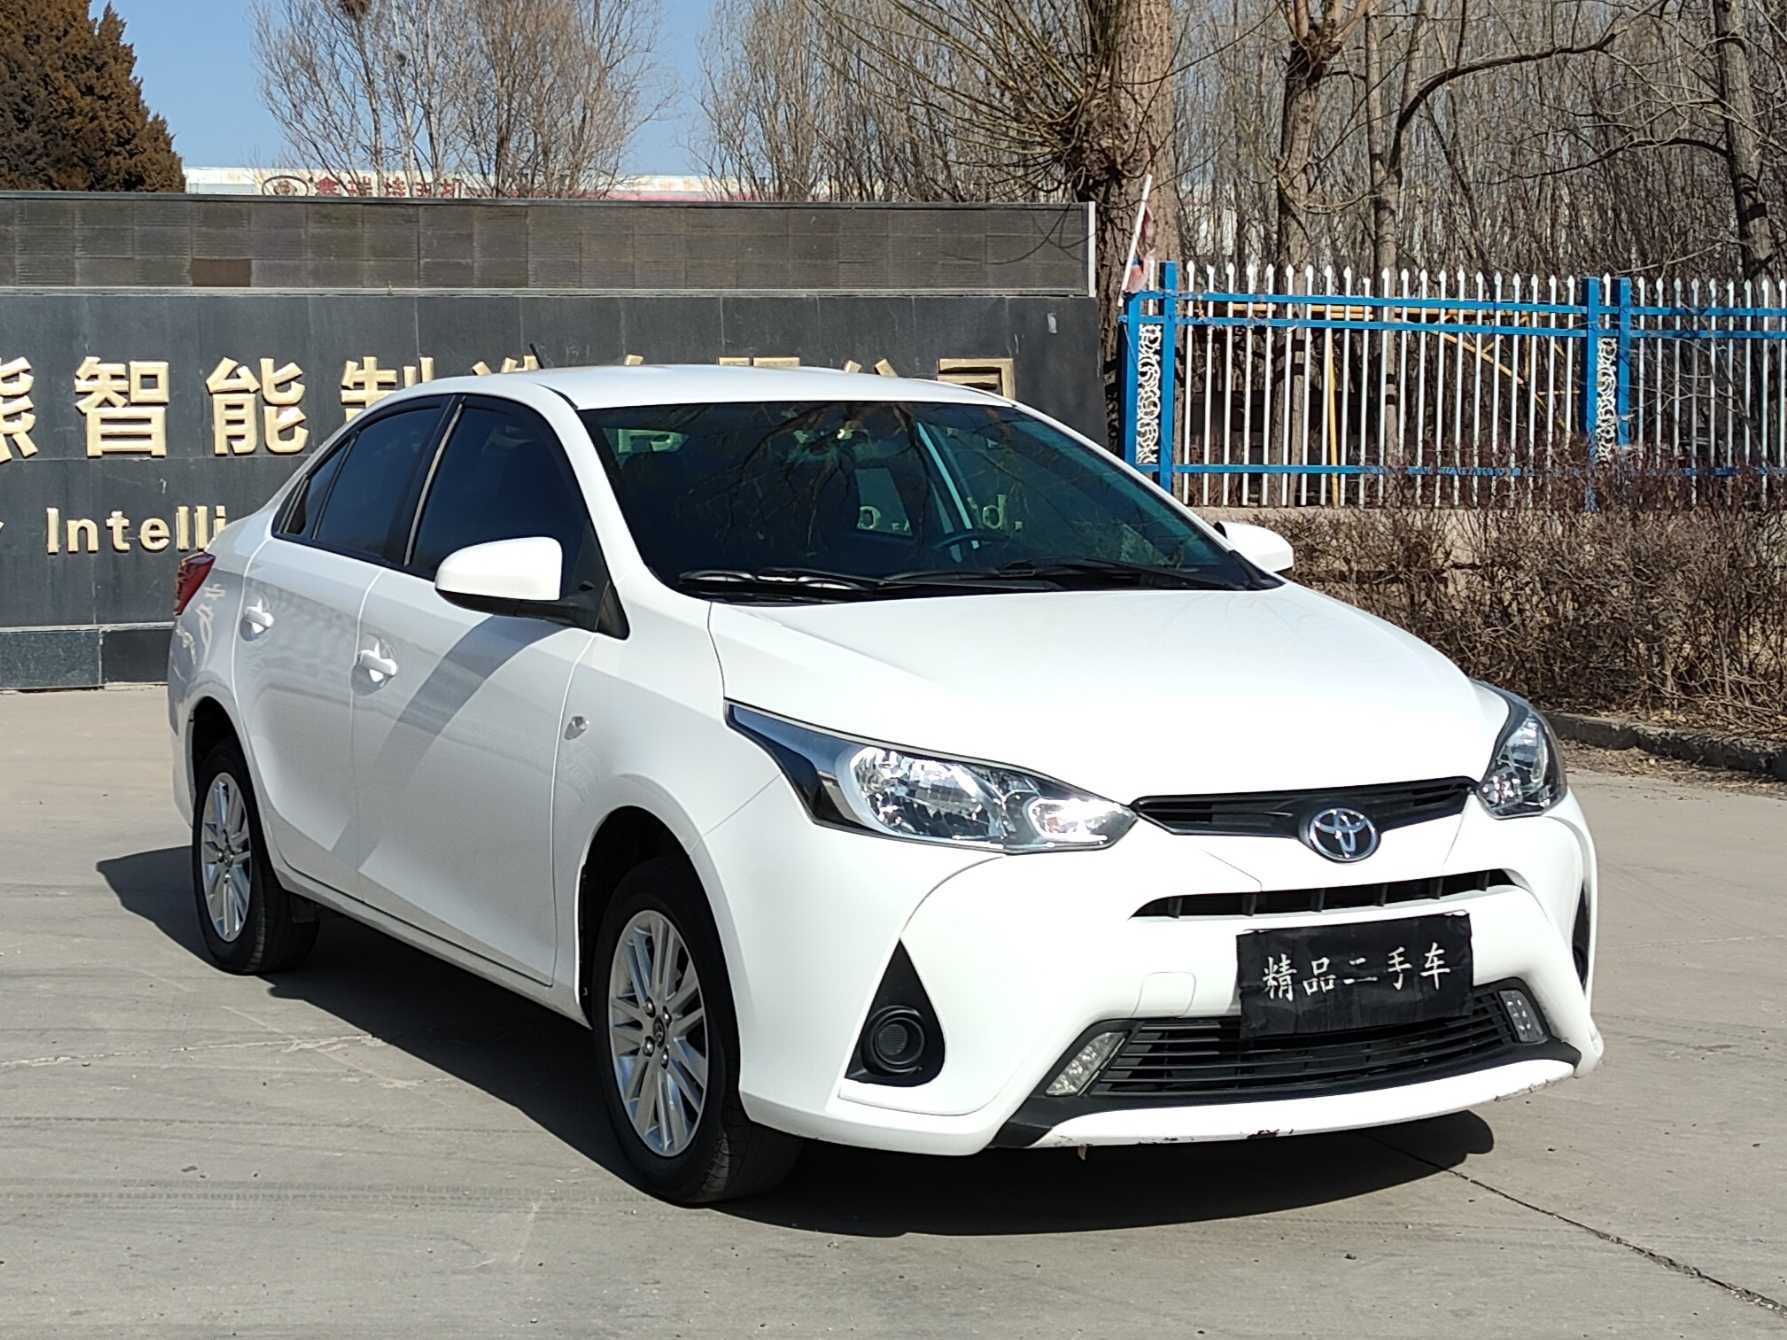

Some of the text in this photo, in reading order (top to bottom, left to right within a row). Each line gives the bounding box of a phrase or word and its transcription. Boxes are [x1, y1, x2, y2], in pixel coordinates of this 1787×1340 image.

[1262, 941, 1451, 1002] 精品二手车
